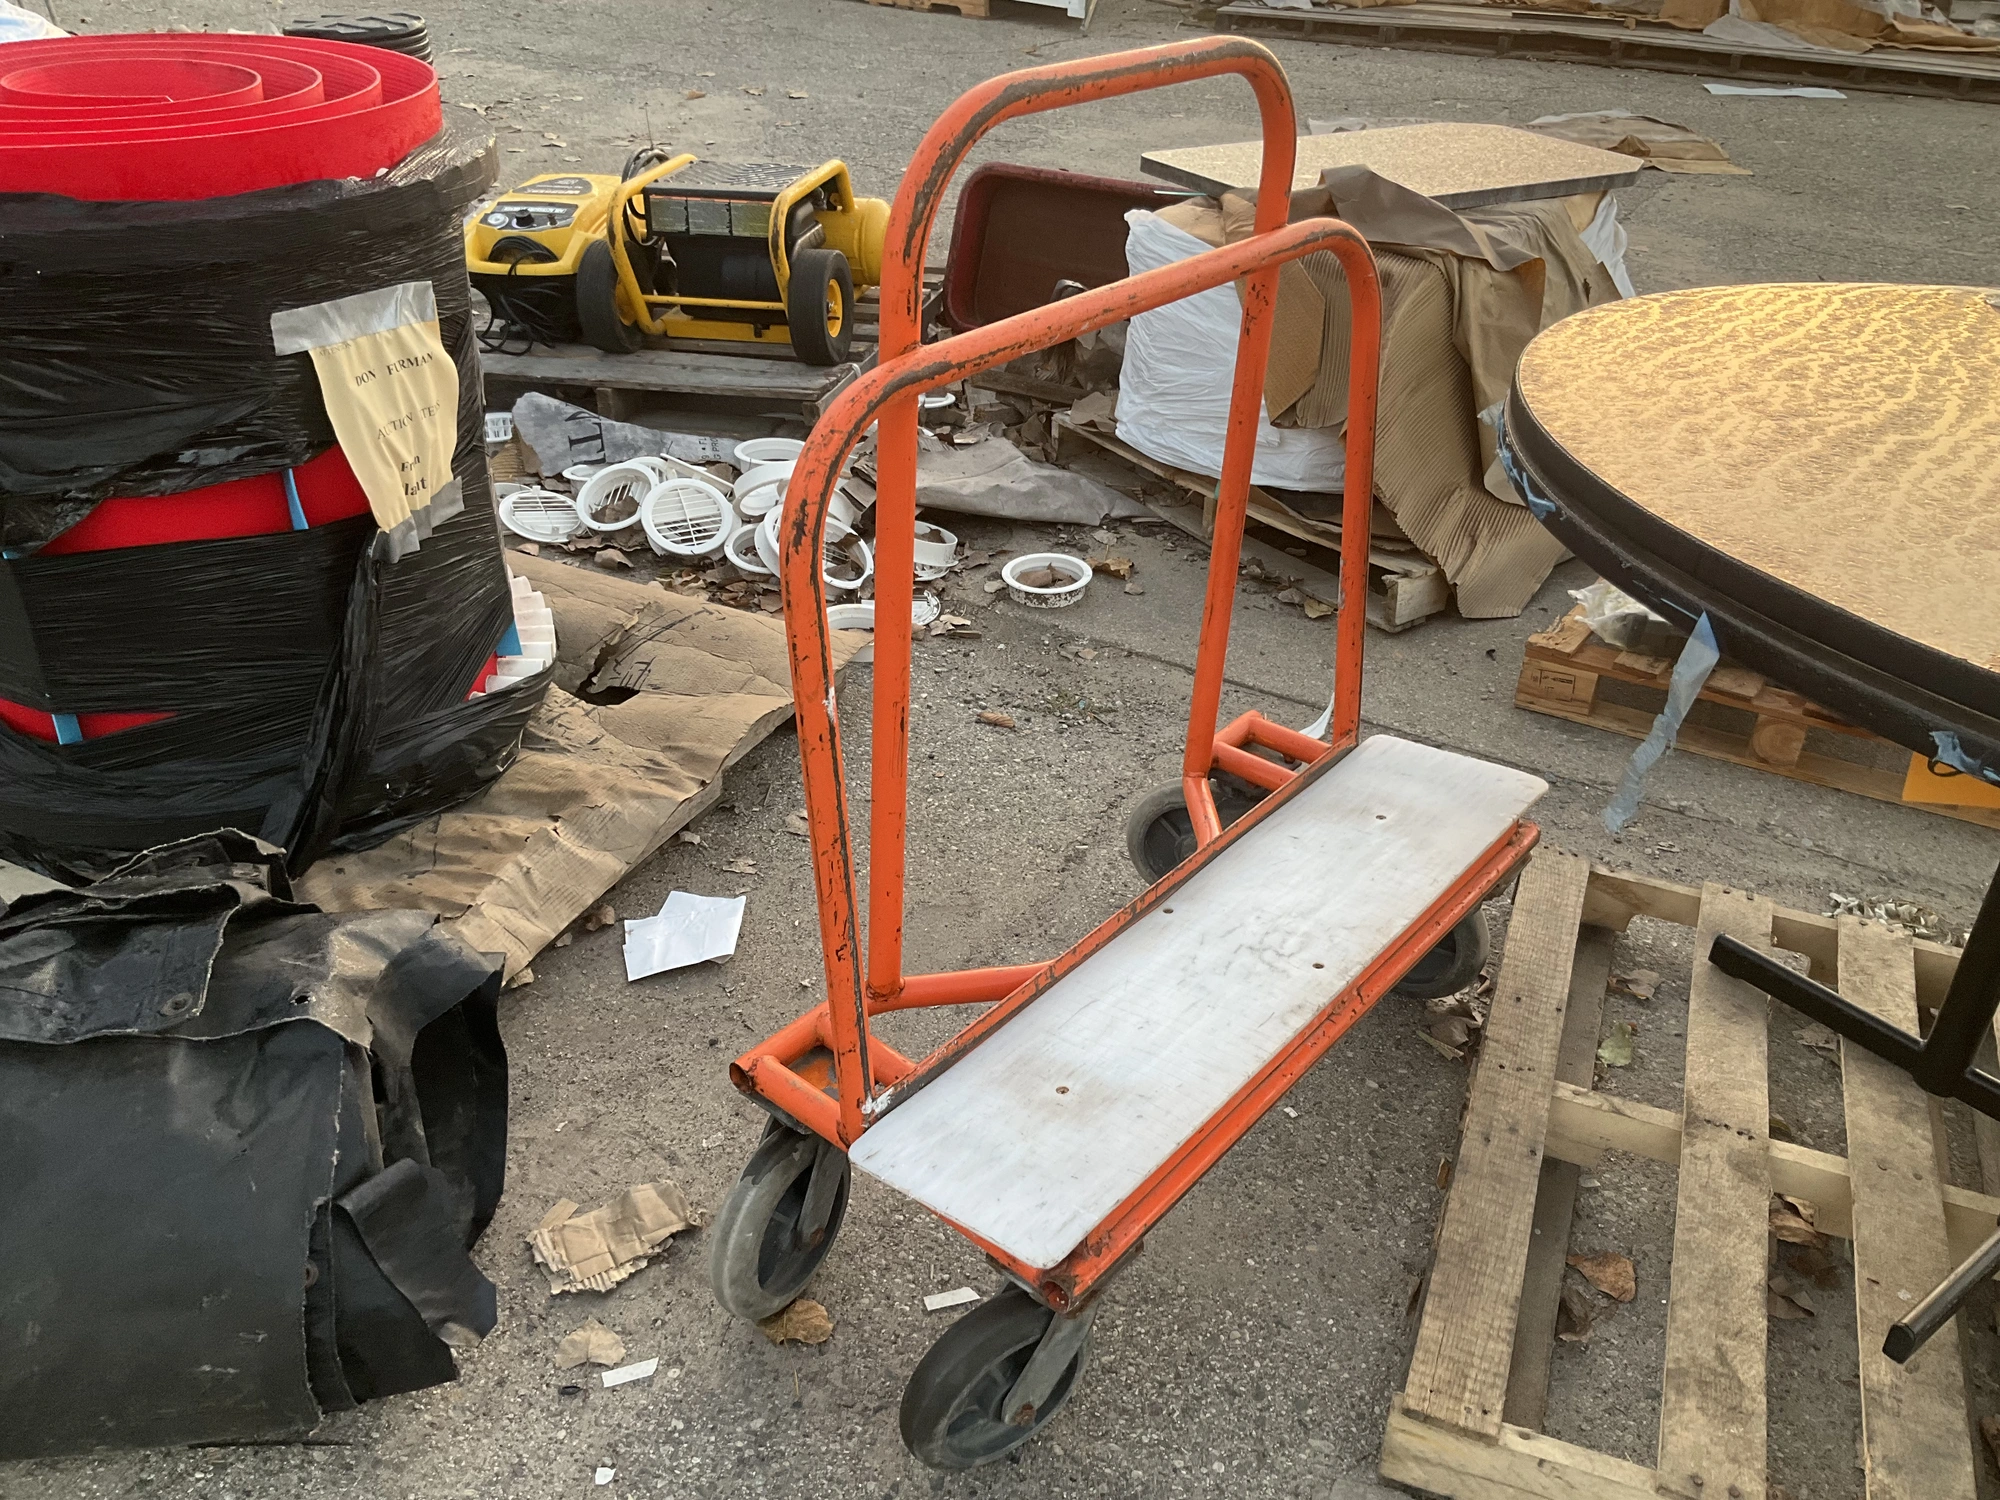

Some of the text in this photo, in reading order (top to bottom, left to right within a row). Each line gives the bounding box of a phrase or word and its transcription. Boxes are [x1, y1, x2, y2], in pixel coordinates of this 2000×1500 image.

[355, 351, 434, 387] DON FURMAN
[420, 400, 441, 421] ITES
